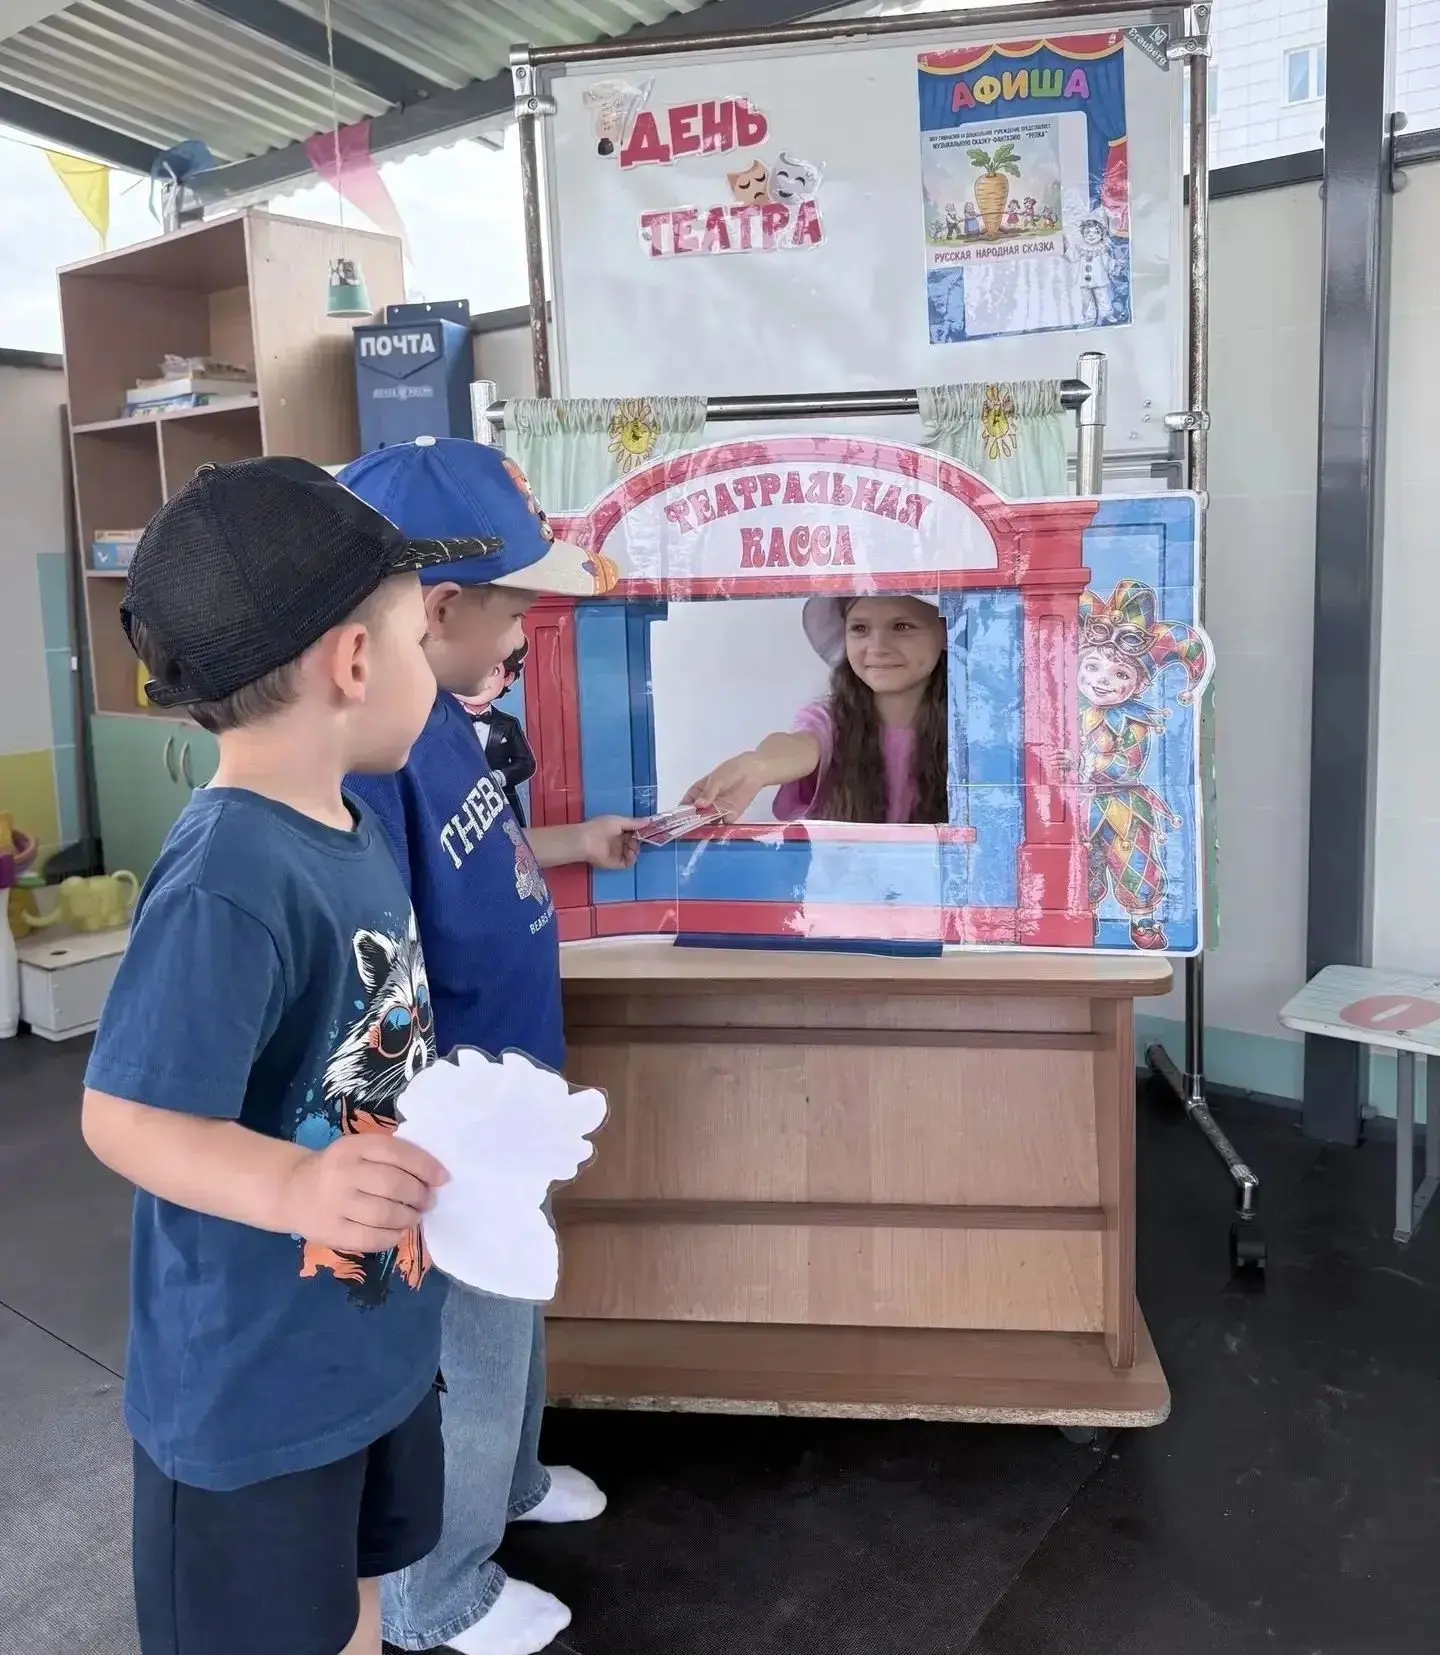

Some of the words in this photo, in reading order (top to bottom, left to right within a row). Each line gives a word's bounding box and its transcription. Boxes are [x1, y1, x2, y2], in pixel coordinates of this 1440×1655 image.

[951, 68, 1090, 113] АФИША
[620, 97, 769, 169] ДЕНЬ
[640, 200, 823, 257] ТЕАТРА
[934, 250, 972, 263] РУССКАЯ
[975, 245, 1020, 259] НАРОДНАЯ
[1022, 241, 1055, 254] СКАЗКА
[360, 332, 436, 357] ПОЧТА
[663, 470, 932, 535] ТЕАТРАЛЬНАЯ
[739, 524, 856, 569] КАССА
[440, 773, 510, 869] THEB
